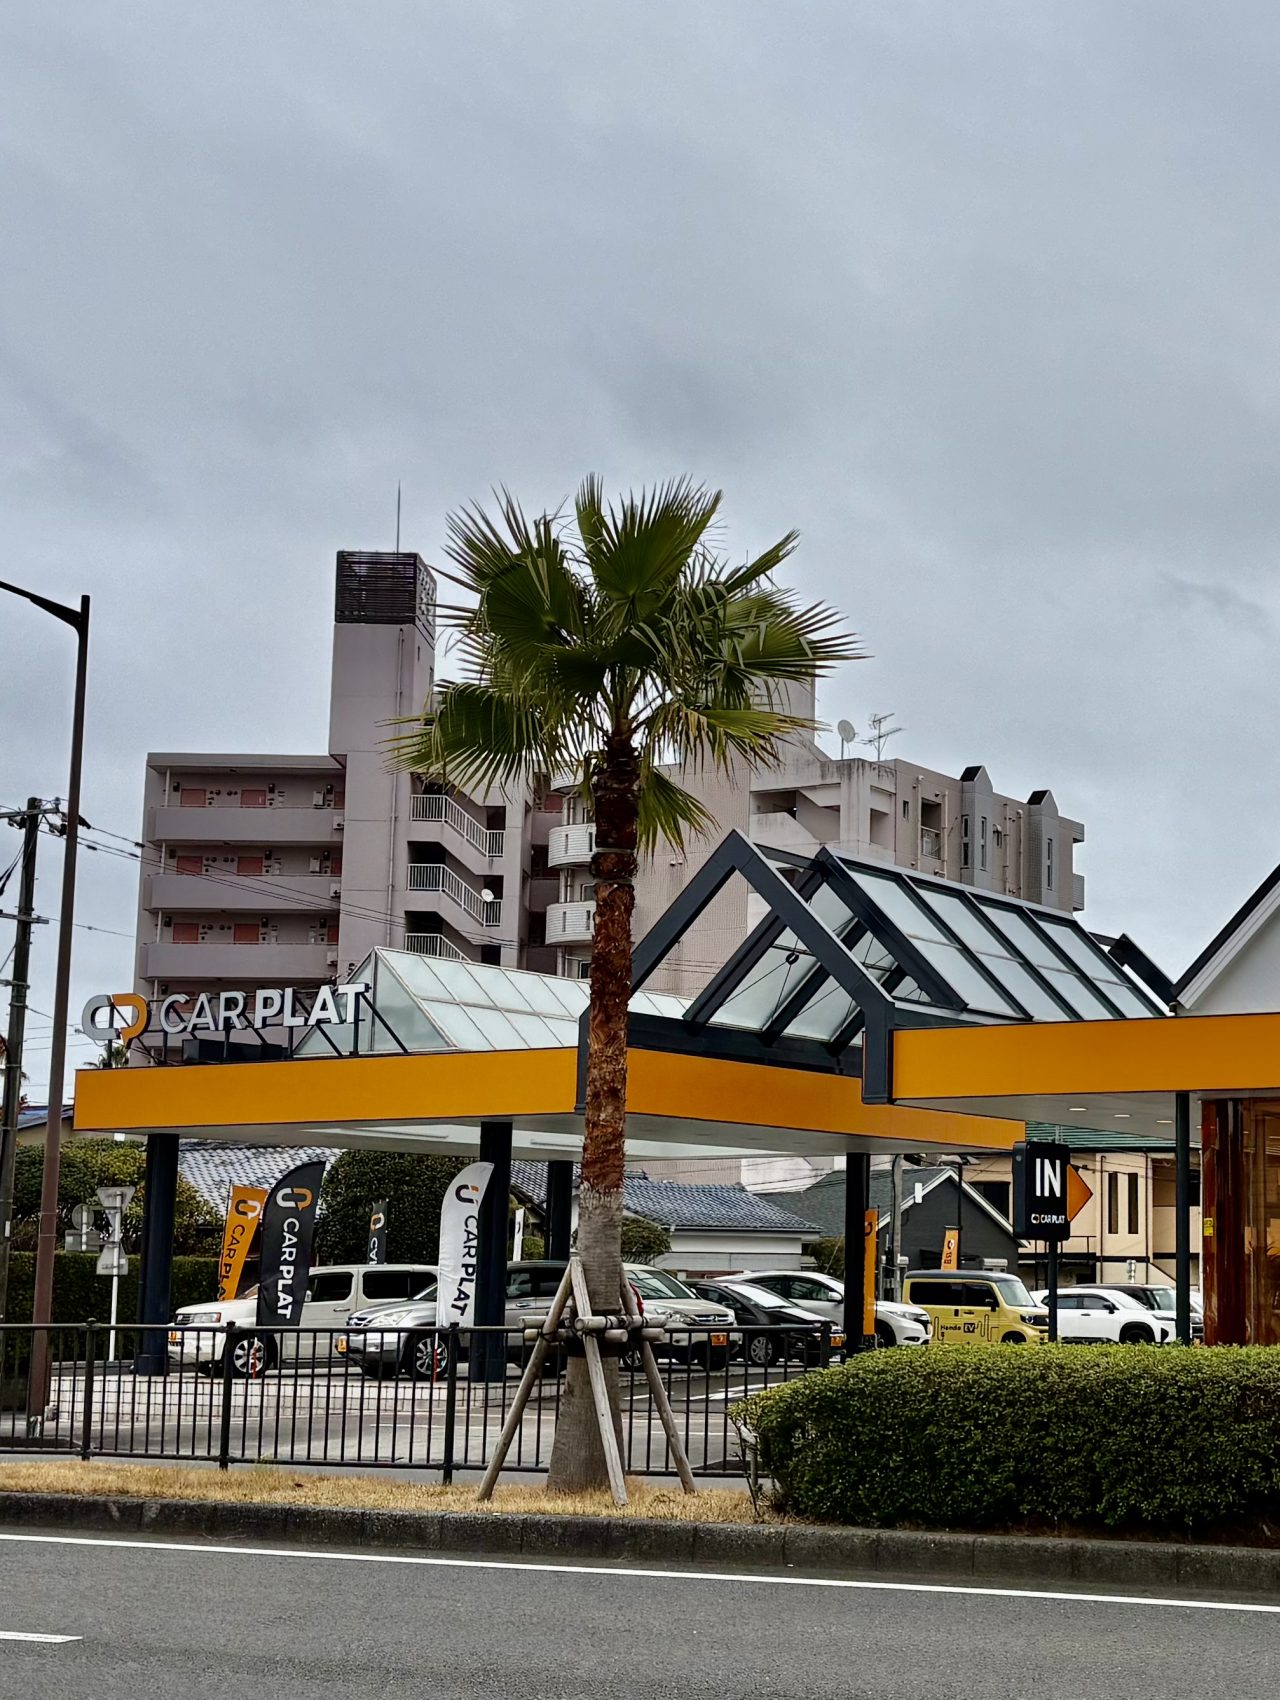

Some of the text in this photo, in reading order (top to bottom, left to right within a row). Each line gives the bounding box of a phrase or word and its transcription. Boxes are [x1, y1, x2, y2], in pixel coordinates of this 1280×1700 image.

[1035, 1157, 1061, 1198] IN
[219, 1262, 232, 1300] PLA
[276, 1217, 300, 1320] CAR PLAT
